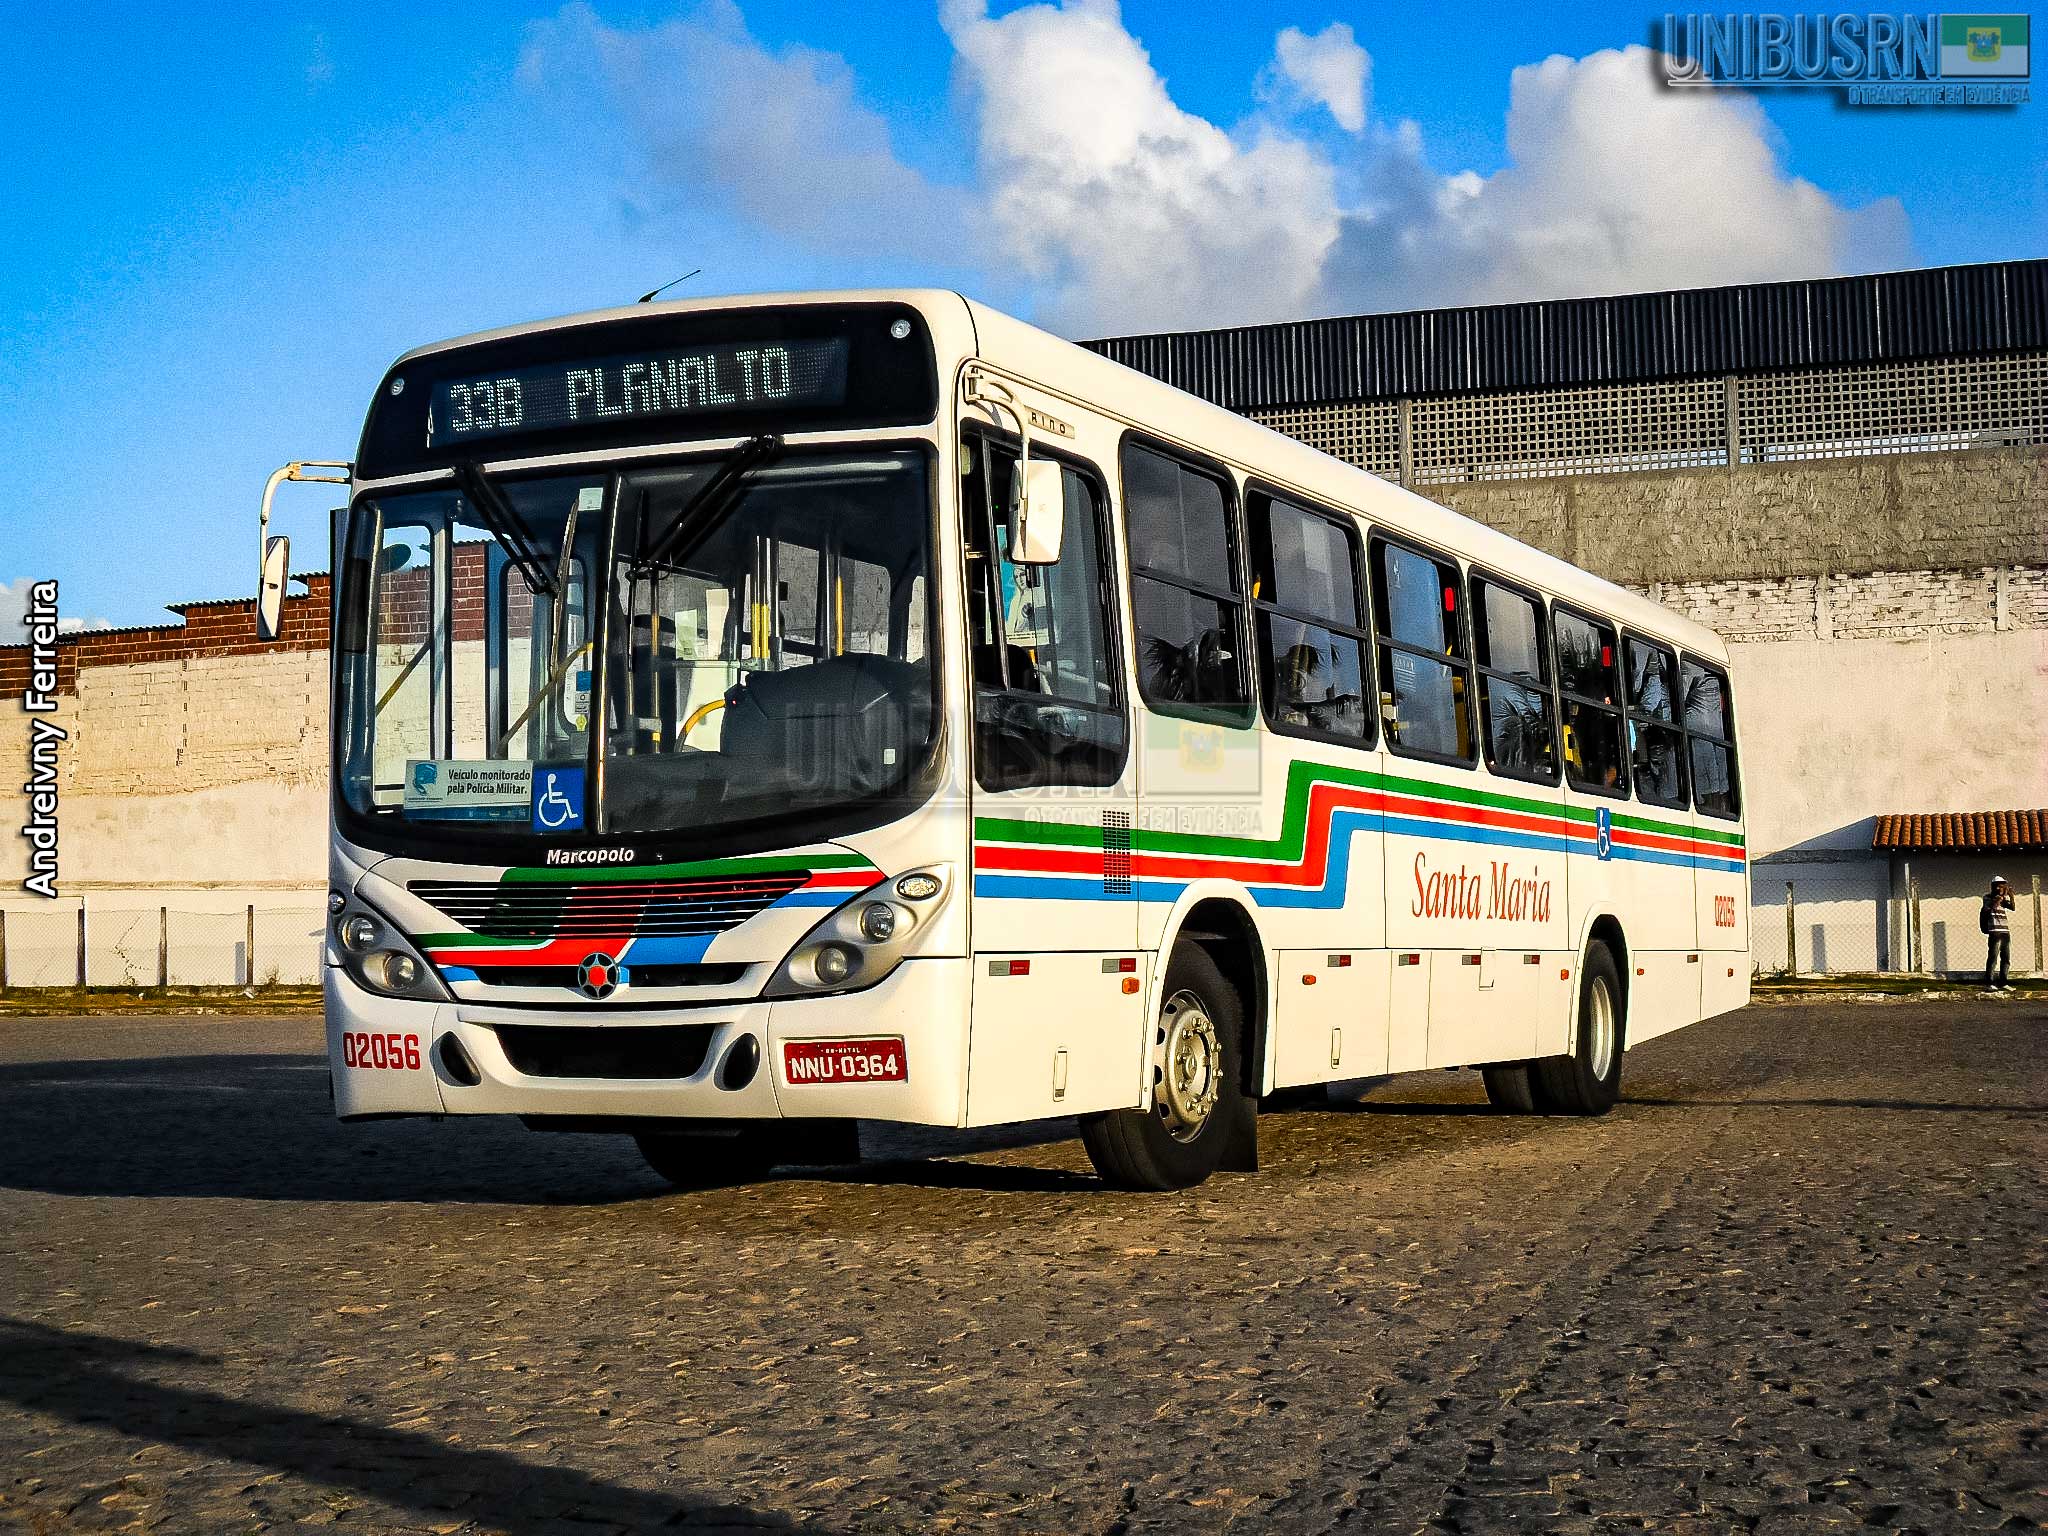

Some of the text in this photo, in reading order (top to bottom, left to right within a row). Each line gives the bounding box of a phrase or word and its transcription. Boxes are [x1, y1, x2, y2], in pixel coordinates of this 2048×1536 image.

[566, 347, 791, 420] PLANALTO
[480, 769, 530, 781] monitorado
[447, 783, 465, 796] pela
[496, 783, 528, 795] Militar.
[546, 847, 635, 865] Marcopolo
[1411, 851, 1551, 923] Santa Maria
[342, 1031, 421, 1070] 02056
